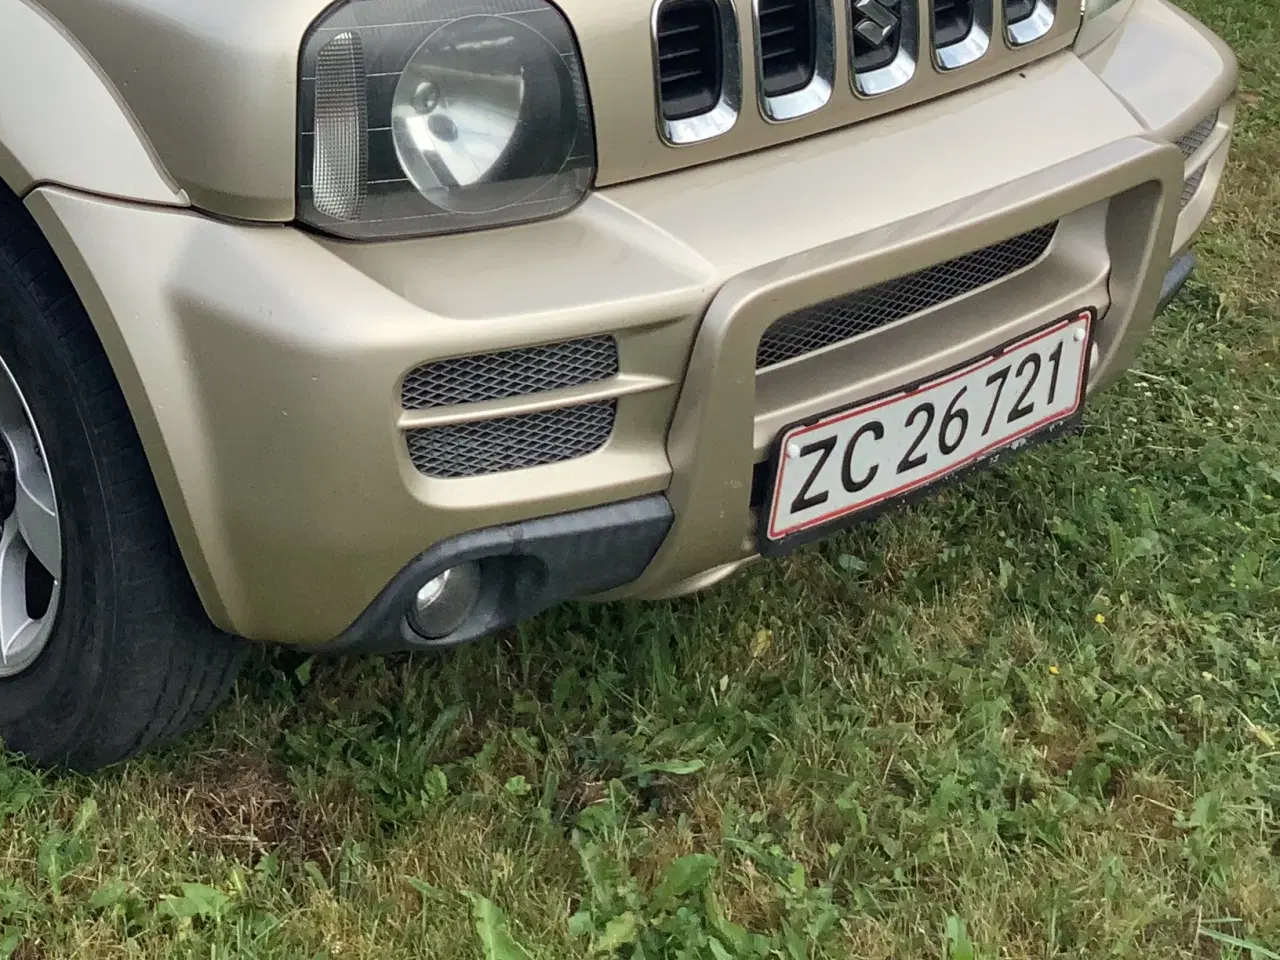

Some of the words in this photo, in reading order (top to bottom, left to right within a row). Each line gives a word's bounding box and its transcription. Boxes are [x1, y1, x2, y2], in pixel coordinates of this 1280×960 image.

[791, 420, 884, 514] ZC
[896, 385, 969, 475] 26
[981, 340, 1064, 437] 721
